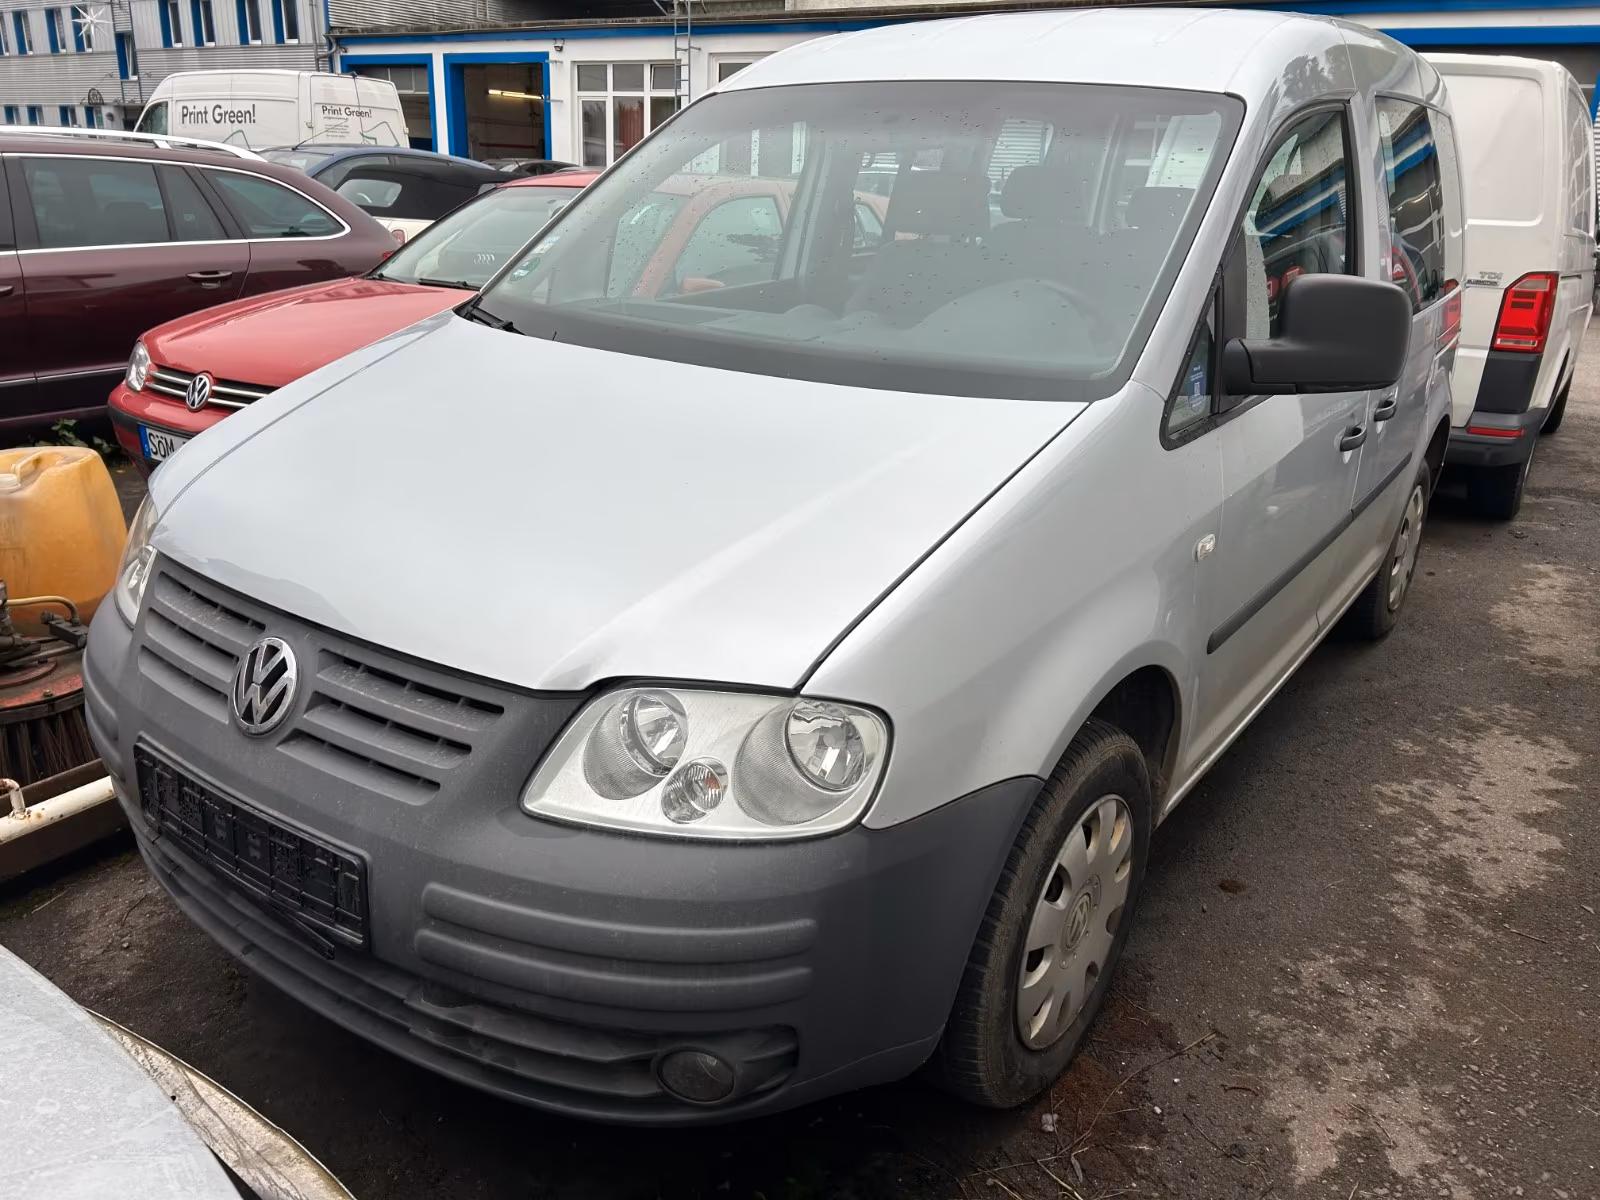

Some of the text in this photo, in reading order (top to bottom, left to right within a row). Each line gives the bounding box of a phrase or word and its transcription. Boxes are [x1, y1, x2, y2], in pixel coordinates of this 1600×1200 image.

[181, 104, 256, 124] Print Green!
[321, 105, 372, 118] Print Green!
[1479, 271, 1503, 280] TDI
[148, 432, 175, 458] SÖM
[233, 637, 297, 733] VW
